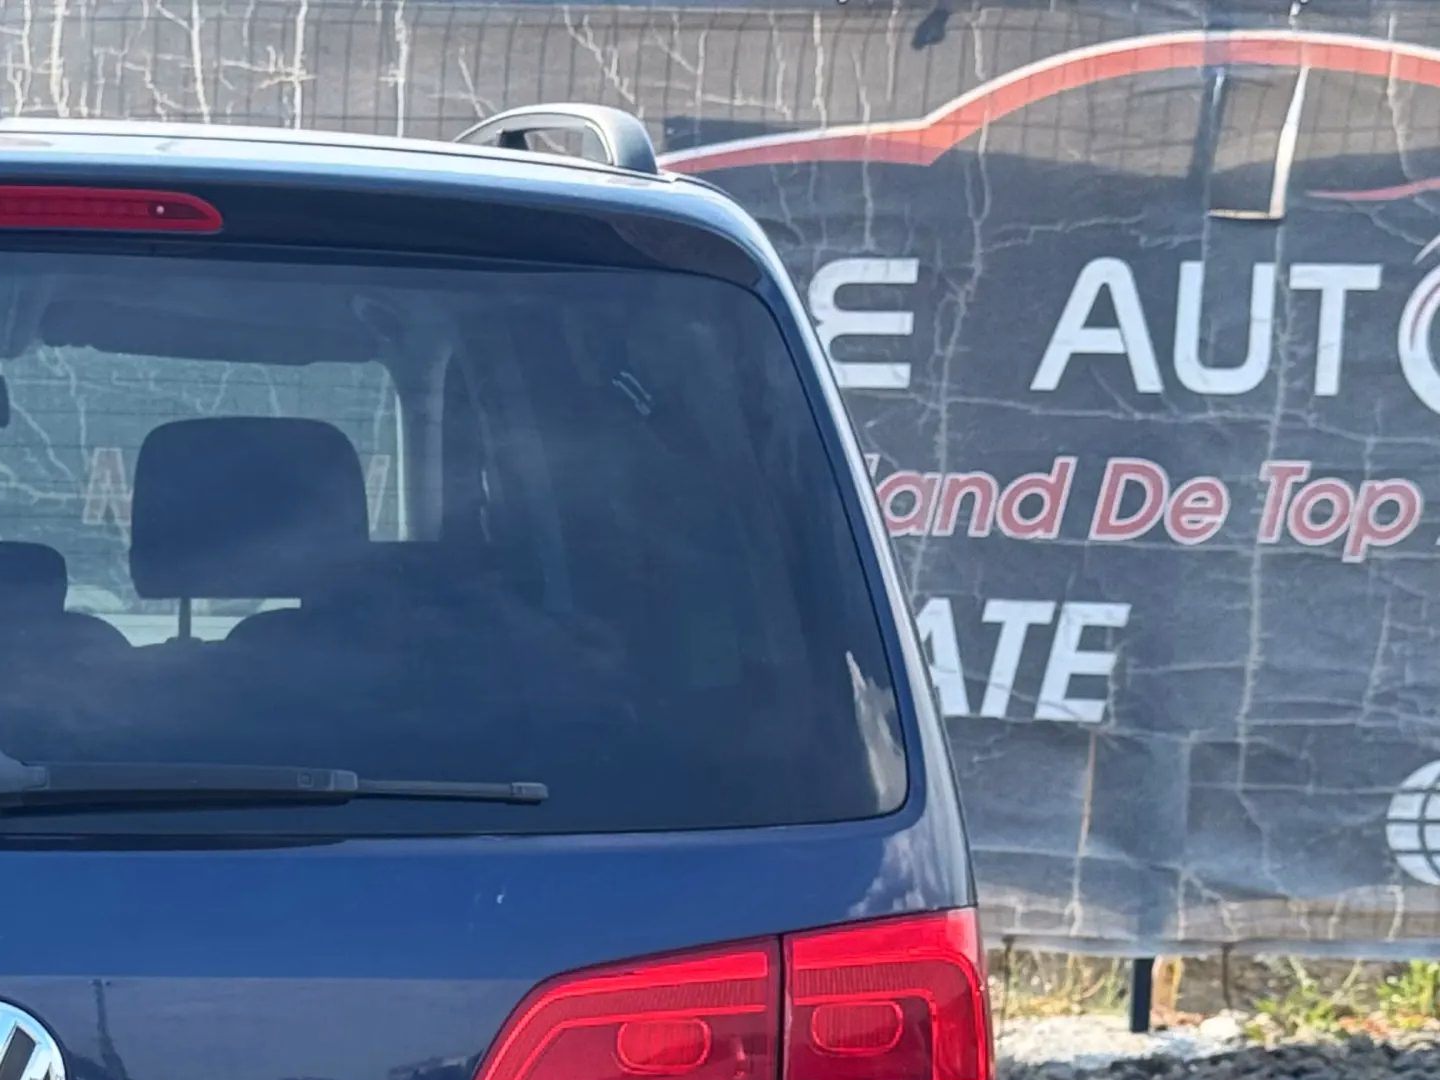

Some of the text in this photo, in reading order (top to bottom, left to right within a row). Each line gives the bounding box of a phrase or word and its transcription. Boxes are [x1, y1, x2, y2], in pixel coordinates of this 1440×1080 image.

[1030, 256, 1440, 417] AUT
[1088, 457, 1228, 545] De
[1260, 460, 1423, 563] Top
